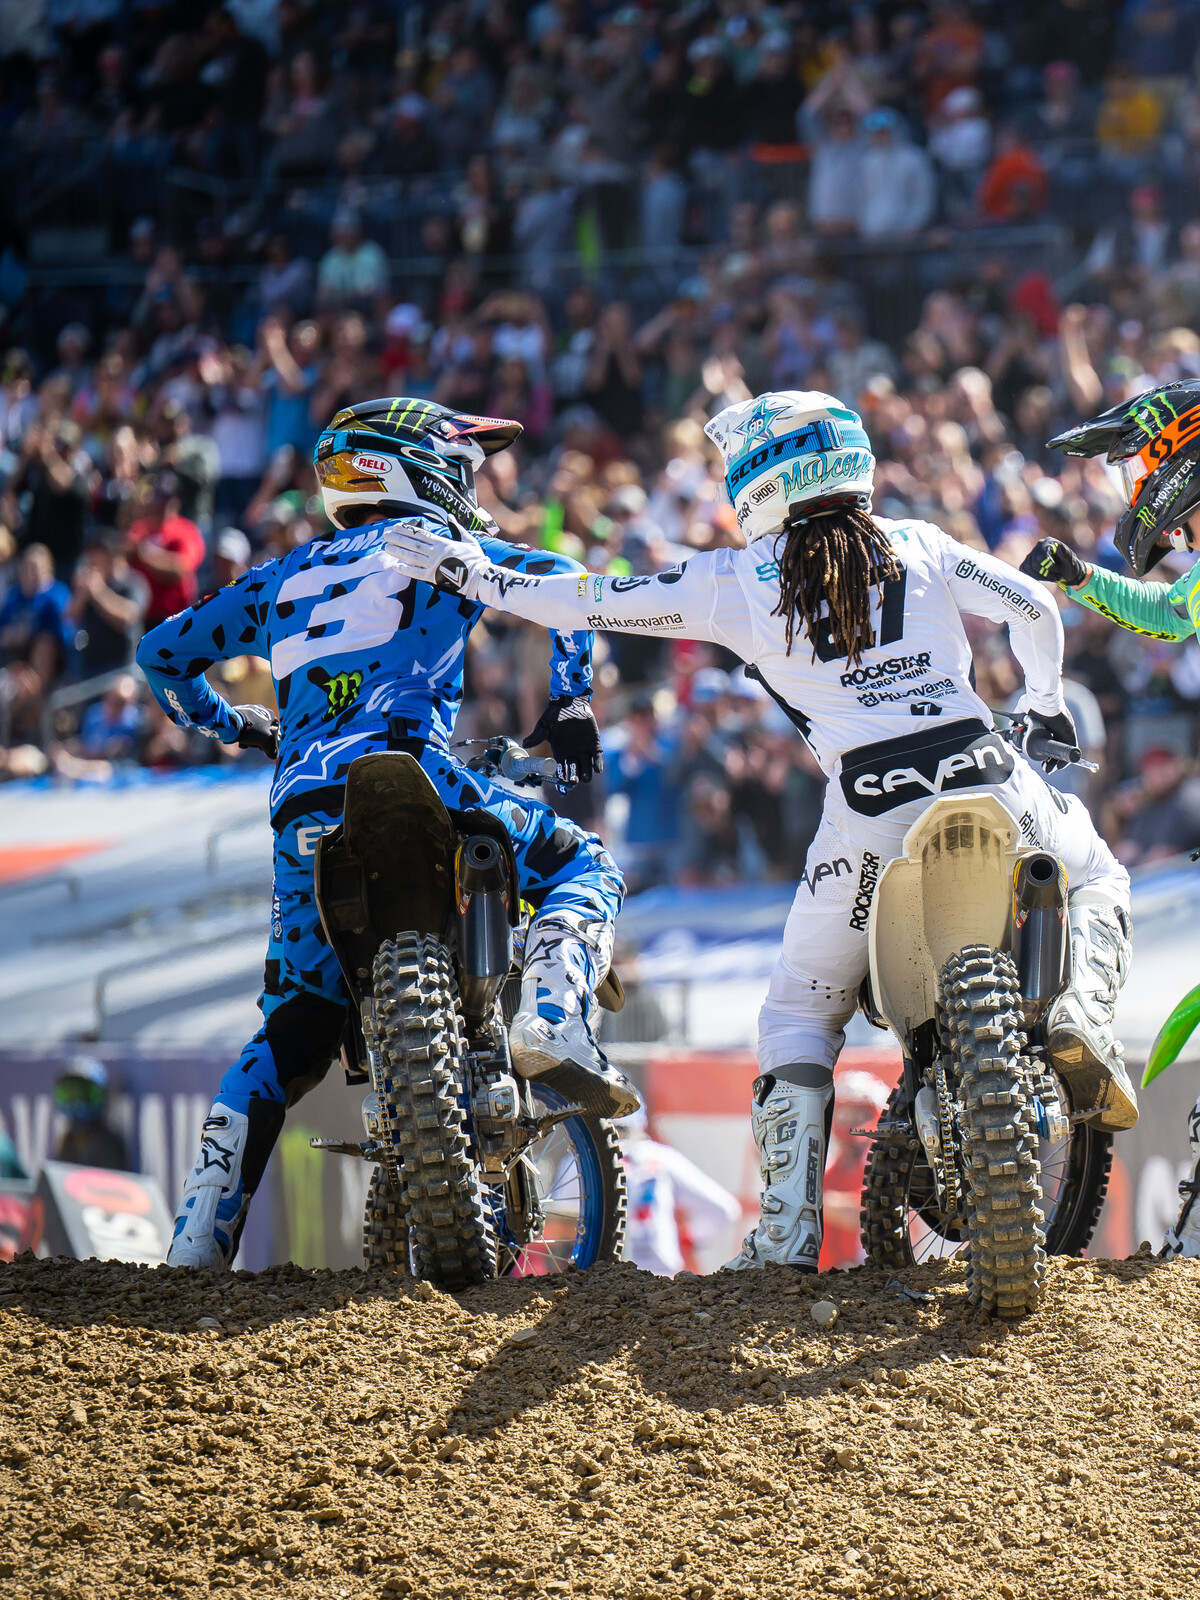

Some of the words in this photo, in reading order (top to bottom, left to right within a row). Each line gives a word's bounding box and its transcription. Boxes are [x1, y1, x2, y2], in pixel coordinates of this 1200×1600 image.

[358, 457, 386, 472] BELL
[730, 431, 815, 489] SCOTT
[421, 475, 473, 519] MONSTER
[751, 482, 777, 504] SHOEI
[1151, 458, 1197, 511] MONSTER
[271, 550, 411, 682] 3
[972, 569, 1042, 621] Husqvarna
[606, 612, 684, 629] Husqvarna
[839, 651, 931, 688] ROCKSTAR
[853, 745, 1004, 797] seven
[801, 857, 853, 897] even
[848, 851, 880, 932] ROCKSTAR
